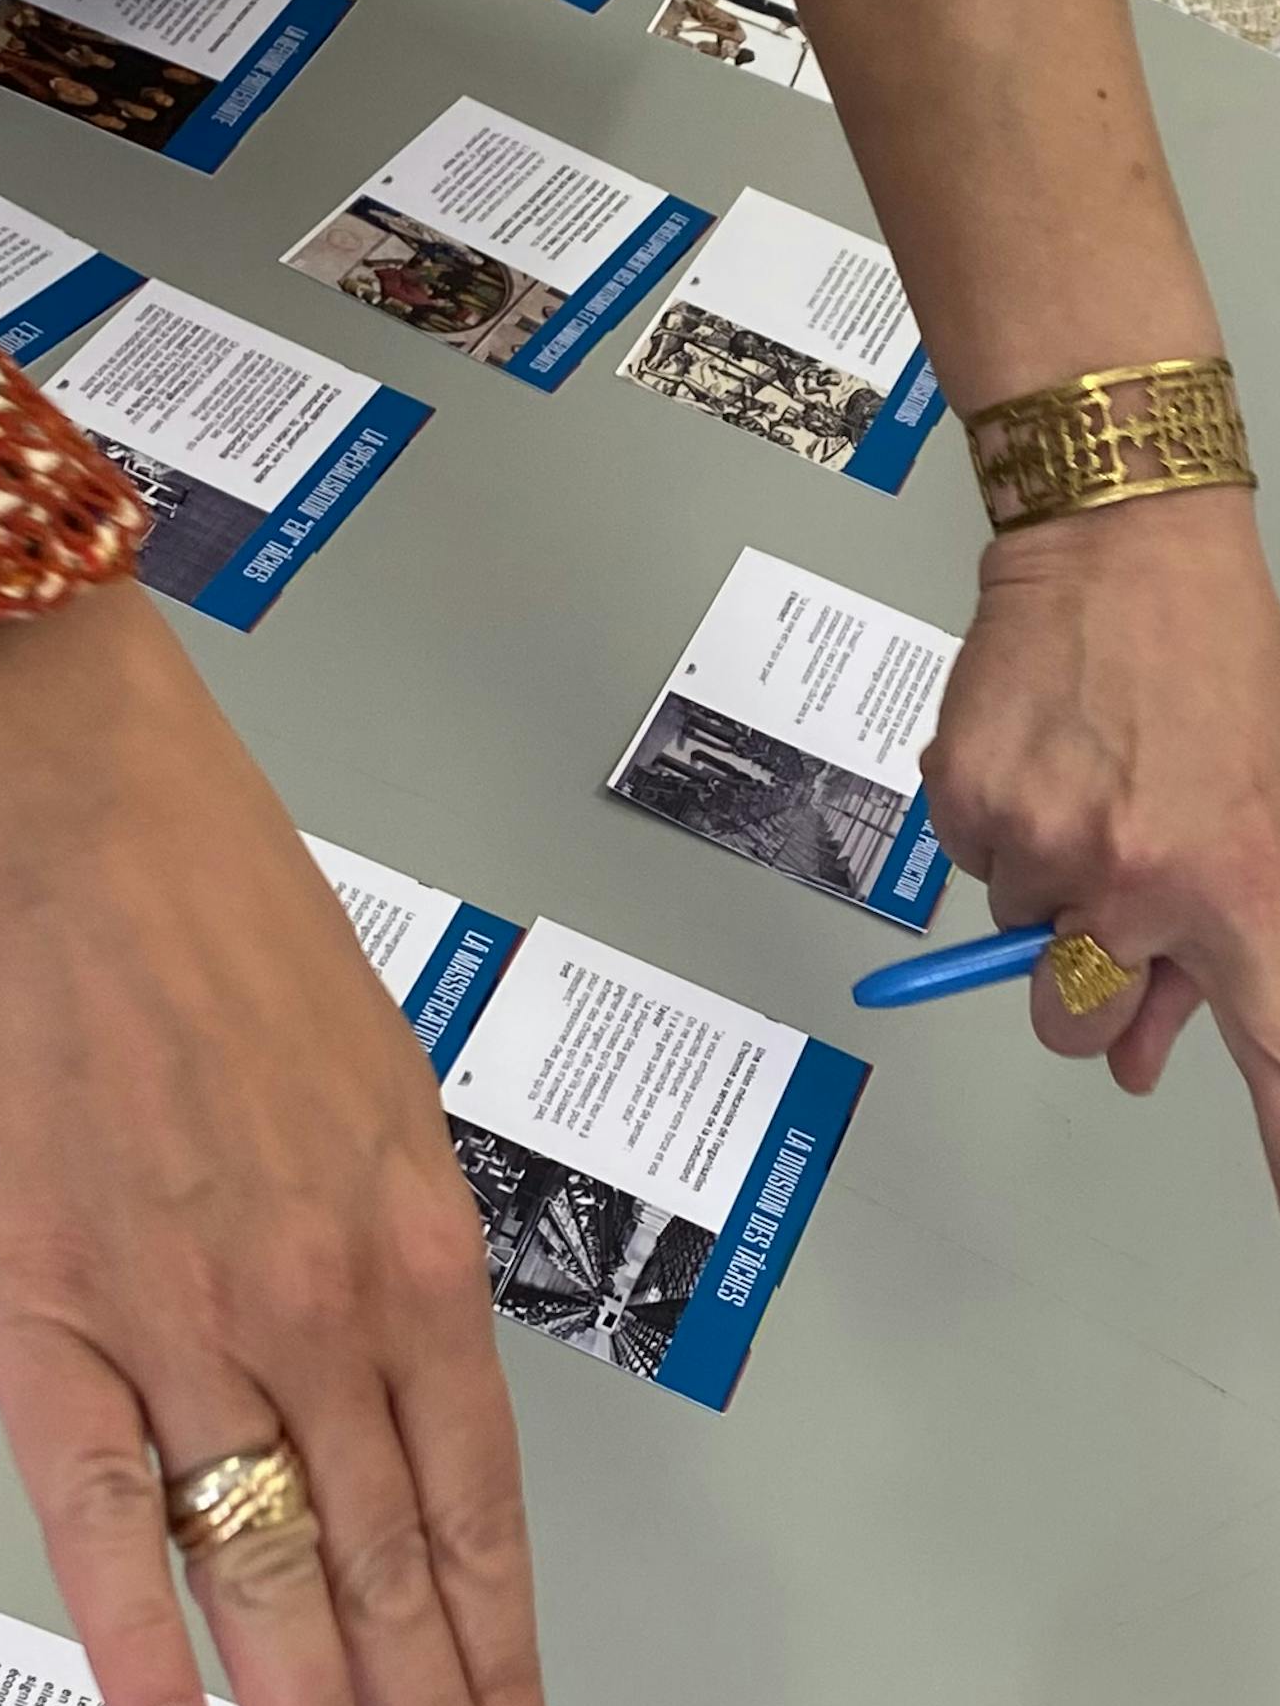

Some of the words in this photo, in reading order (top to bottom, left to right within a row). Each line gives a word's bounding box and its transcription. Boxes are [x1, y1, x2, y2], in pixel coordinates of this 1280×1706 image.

[358, 426, 388, 447] LA
[296, 439, 377, 520] SPÉCIALISATION
[241, 539, 294, 583] TÂCHES
[891, 832, 940, 902] PRODUCTION
[460, 928, 494, 954] LA
[782, 1126, 816, 1153] LA
[754, 1146, 807, 1219] DIVISION
[741, 1211, 779, 1249] DES
[715, 1243, 767, 1308] TÂCHES
[57, 1687, 72, 1704] en
